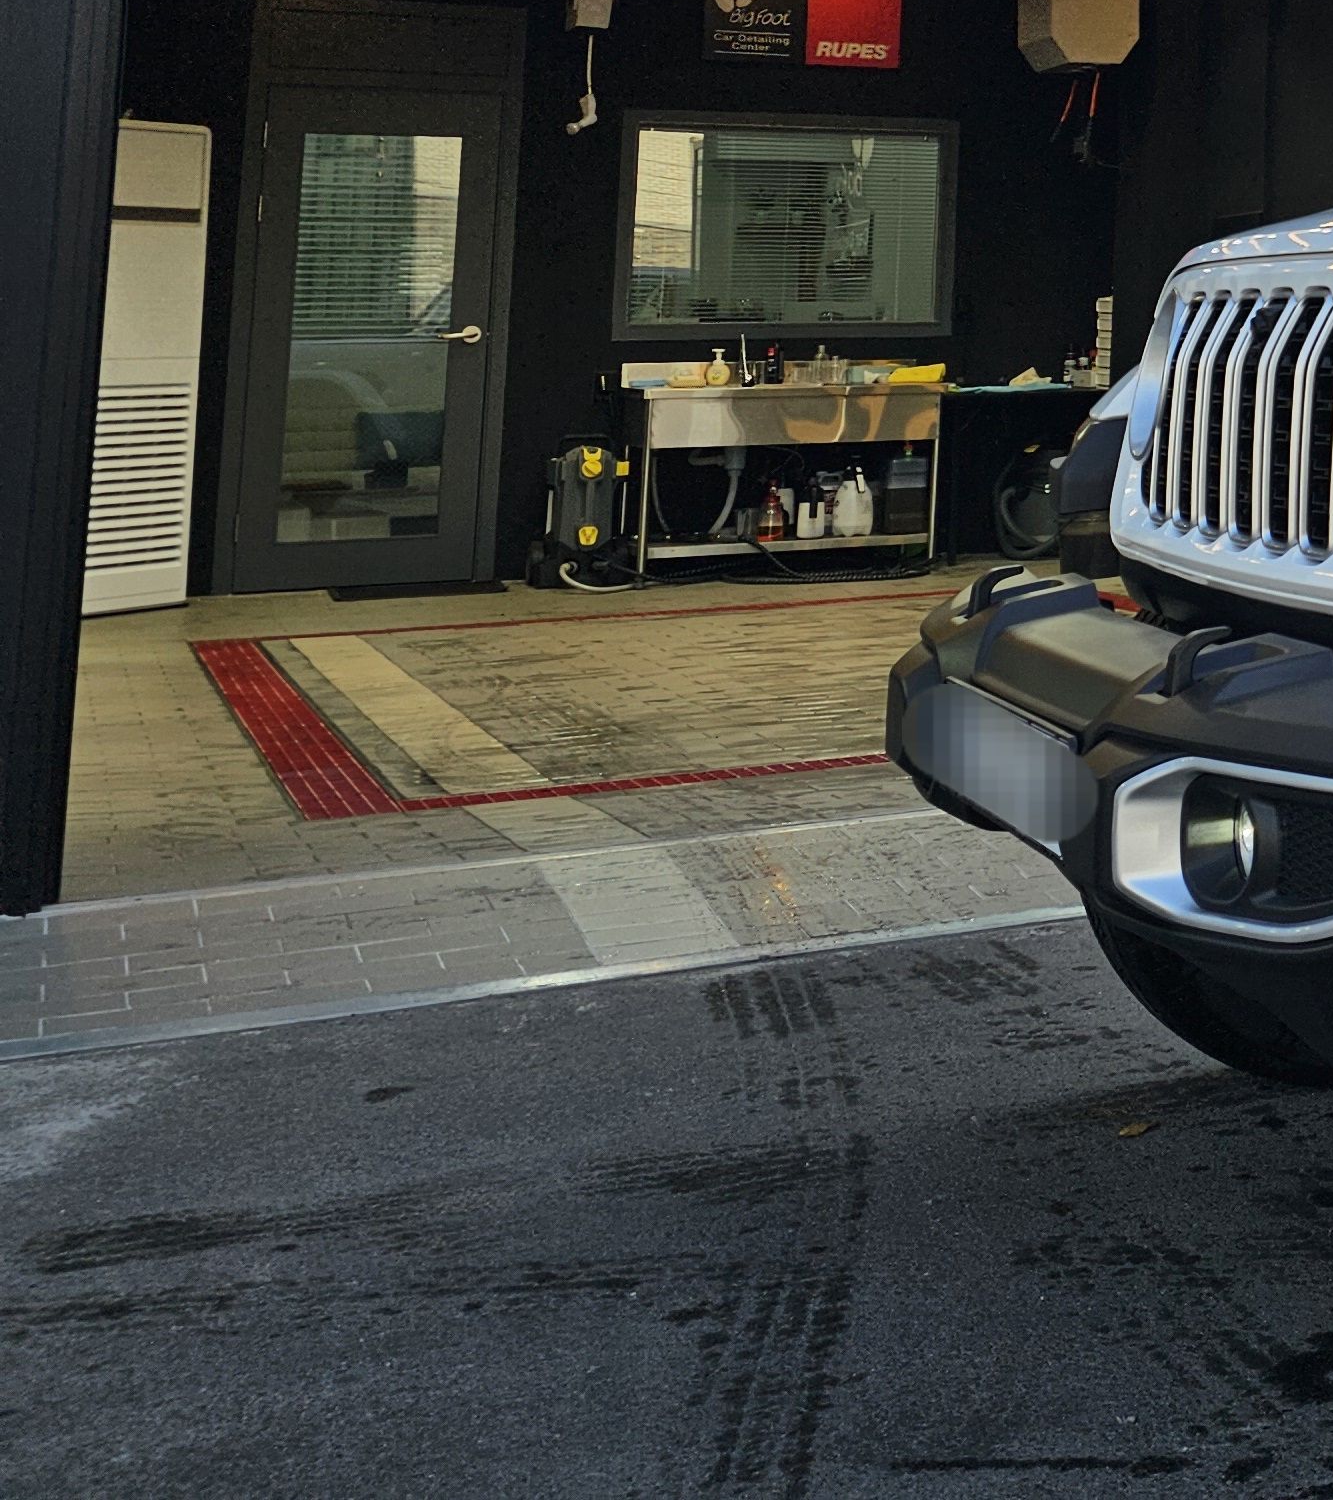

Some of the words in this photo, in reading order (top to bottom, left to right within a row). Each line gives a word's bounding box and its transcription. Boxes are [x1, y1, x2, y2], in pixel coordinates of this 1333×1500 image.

[713, 33, 733, 42] Car
[738, 33, 790, 46] Detailing
[731, 41, 770, 51] Center
[815, 41, 888, 61] RUPES
